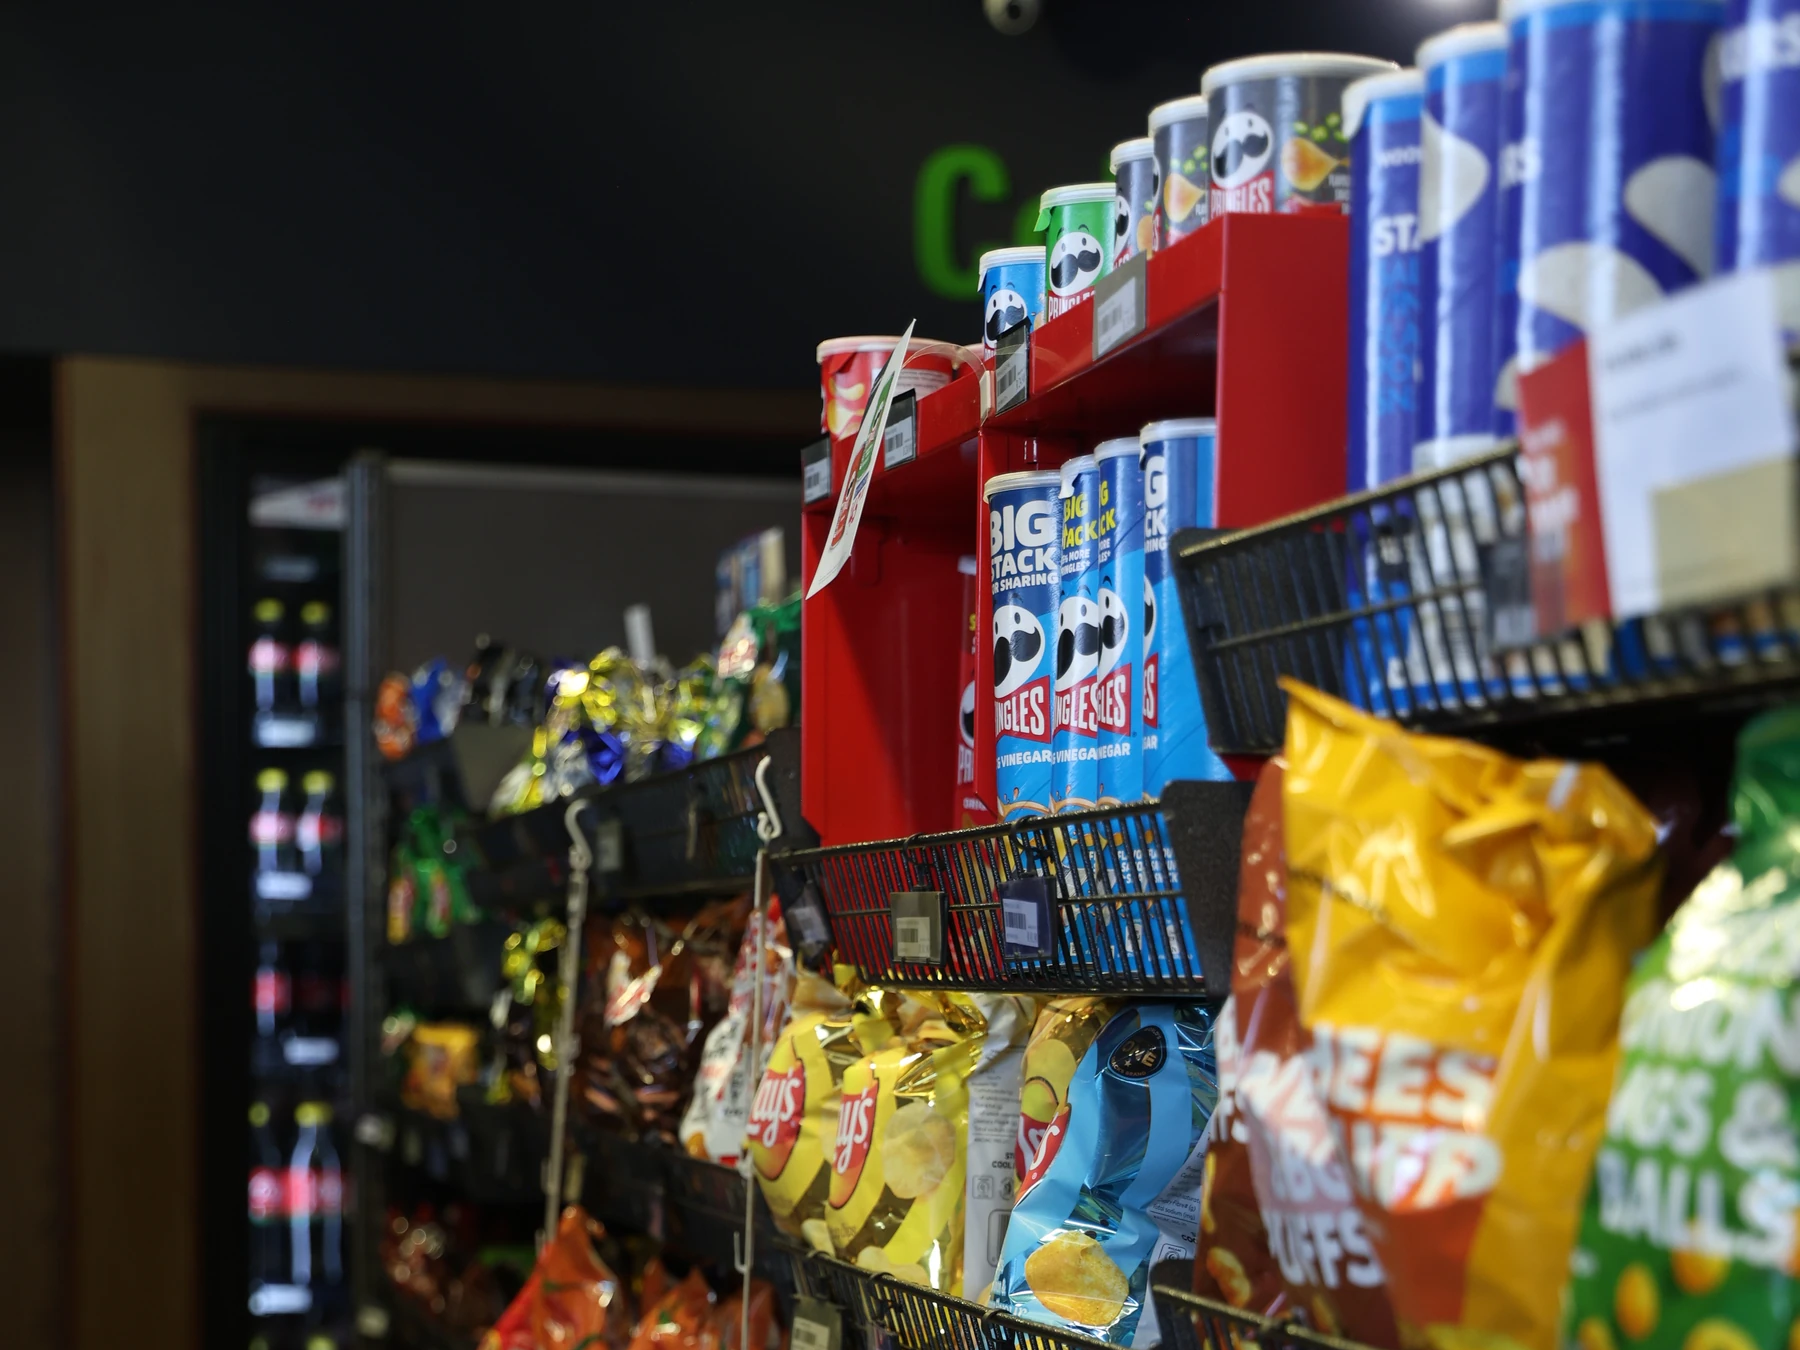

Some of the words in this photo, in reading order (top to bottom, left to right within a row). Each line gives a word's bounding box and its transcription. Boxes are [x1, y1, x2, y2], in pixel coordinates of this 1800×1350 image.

[1000, 571, 1059, 592] SHARING
[1001, 750, 1051, 767] VINEGAR
[1058, 748, 1098, 765] VINEGA
